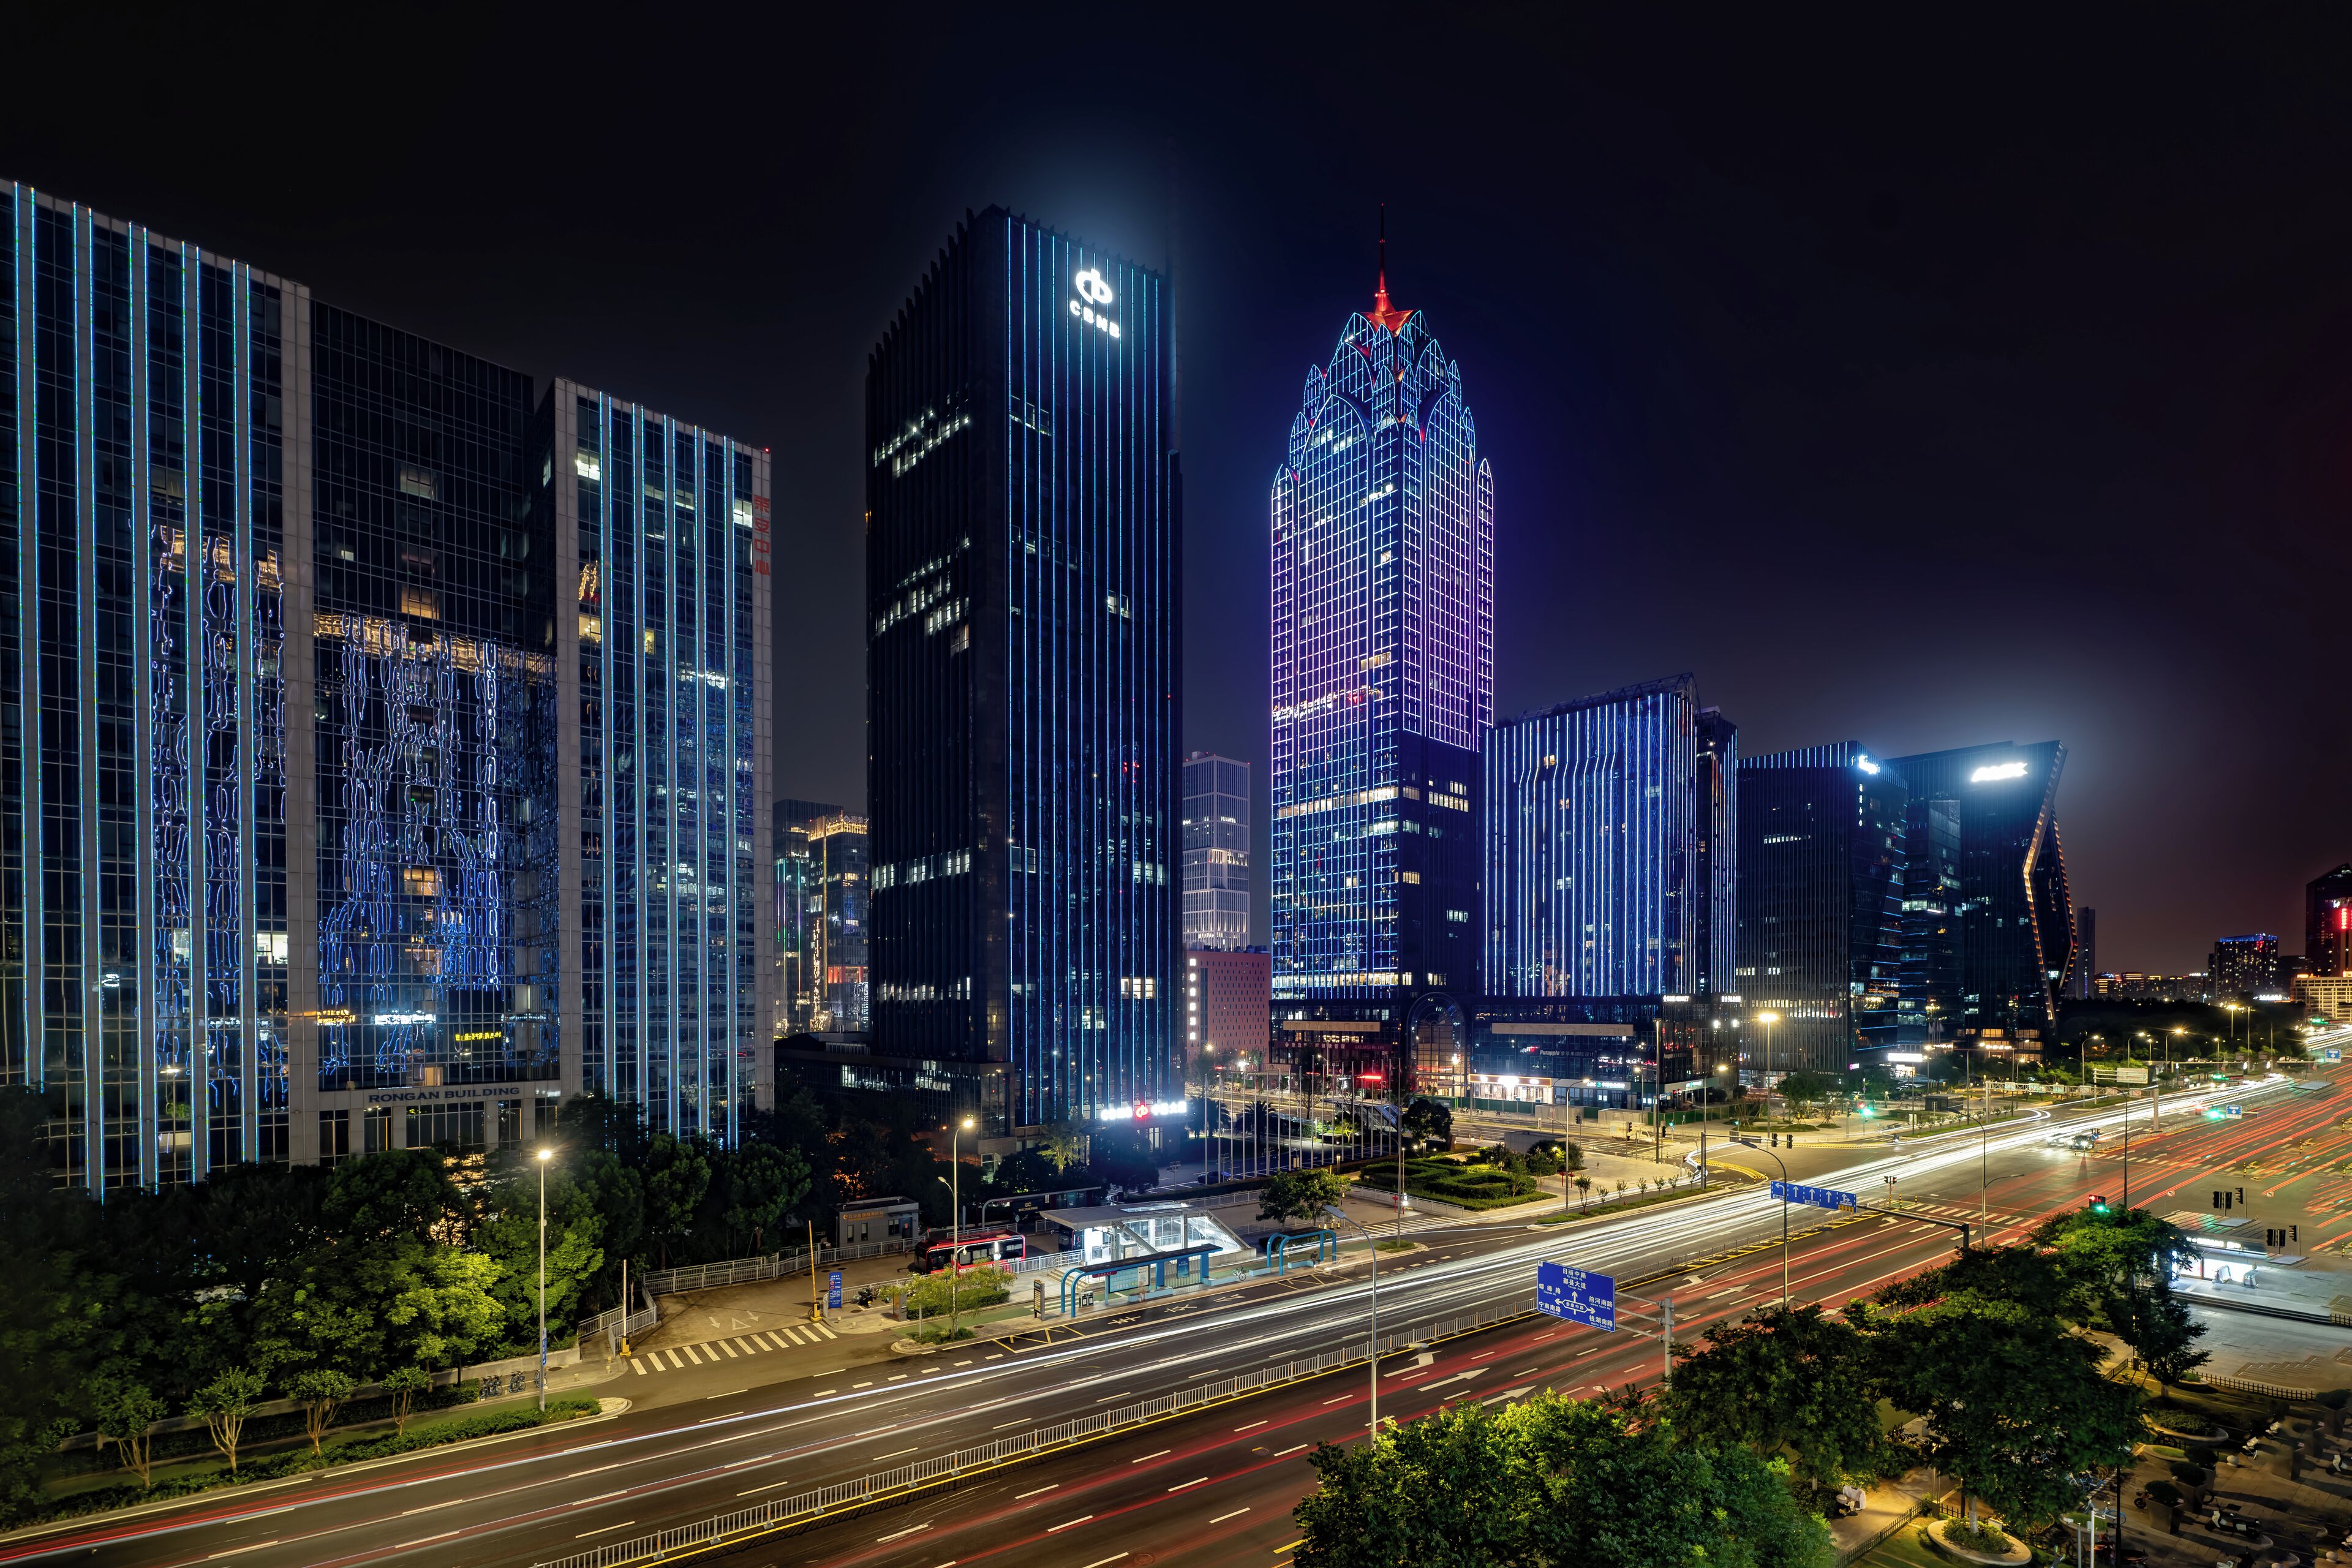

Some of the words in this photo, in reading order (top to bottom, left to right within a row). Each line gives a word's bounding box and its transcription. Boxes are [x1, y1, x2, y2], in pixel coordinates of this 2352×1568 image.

[1069, 300, 1120, 339] CBMB
[754, 494, 770, 576] 荣安中心
[368, 1092, 440, 1103] RONGAN
[444, 1087, 521, 1099] BUILDING
[1562, 1268, 1586, 1279] 日丽中路
[1539, 1301, 1561, 1313] 宁南南路
[1589, 1295, 1613, 1308] 前河南路
[1589, 1315, 1613, 1327] 钱湖南路
